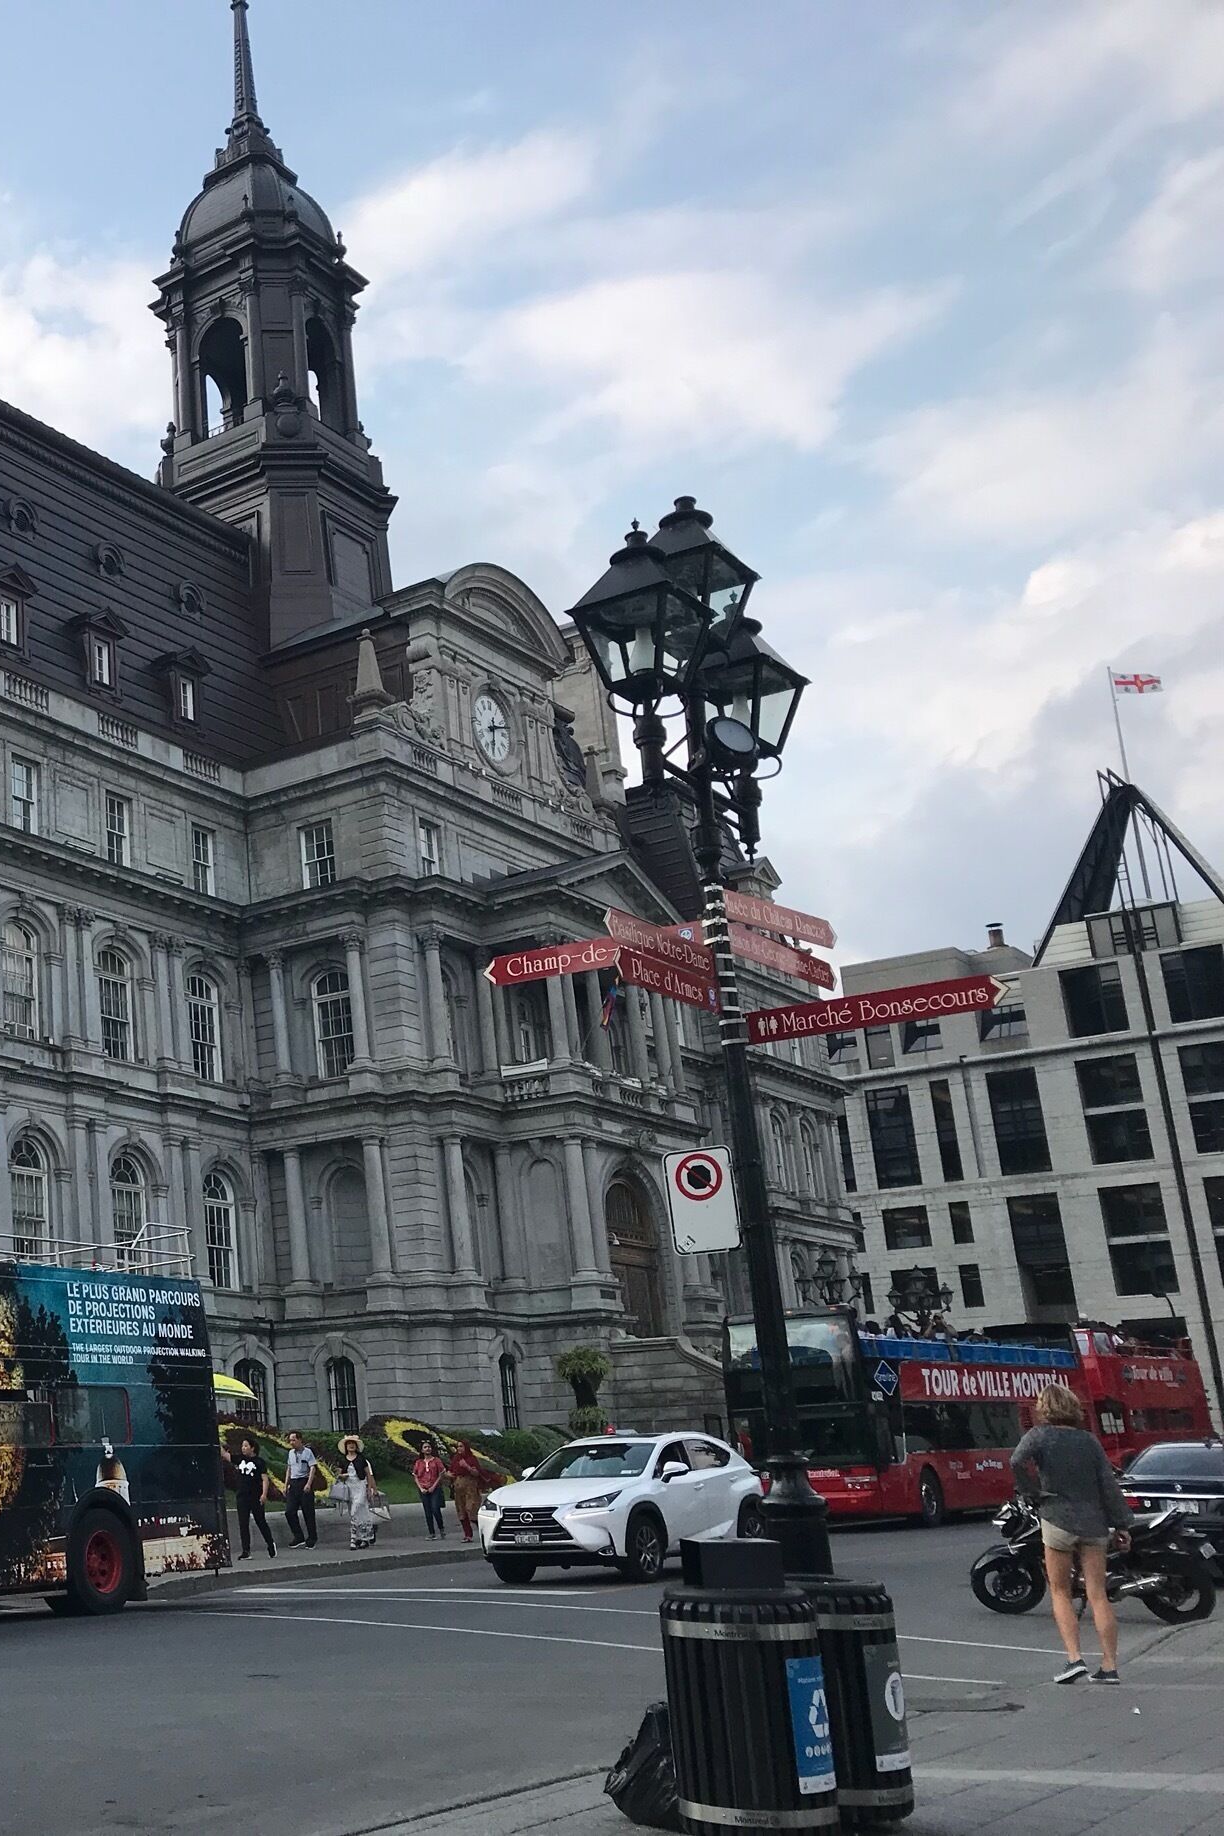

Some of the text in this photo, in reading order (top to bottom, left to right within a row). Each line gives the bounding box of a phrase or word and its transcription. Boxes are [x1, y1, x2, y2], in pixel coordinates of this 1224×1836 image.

[612, 914, 711, 972] Basilique Notre-Dame
[506, 944, 618, 975] Champ-de-
[631, 957, 704, 1002] Place d'Armes
[780, 986, 989, 1033] Marché Bonsecours
[67, 1281, 201, 1307] LE PLUS GRAND PARCOURS
[68, 1299, 156, 1320] DE PROJECTIONS
[70, 1313, 194, 1339] EXTÉRIEURES AU MONDE
[72, 1342, 206, 1358] THE LARGEST OUTDOOR PROJECTION WALKING
[72, 1353, 134, 1365] TOUR IN THE WORLD
[921, 1368, 960, 1397] TOUR
[962, 1368, 977, 1396] de
[976, 1370, 1011, 1398] VILLE
